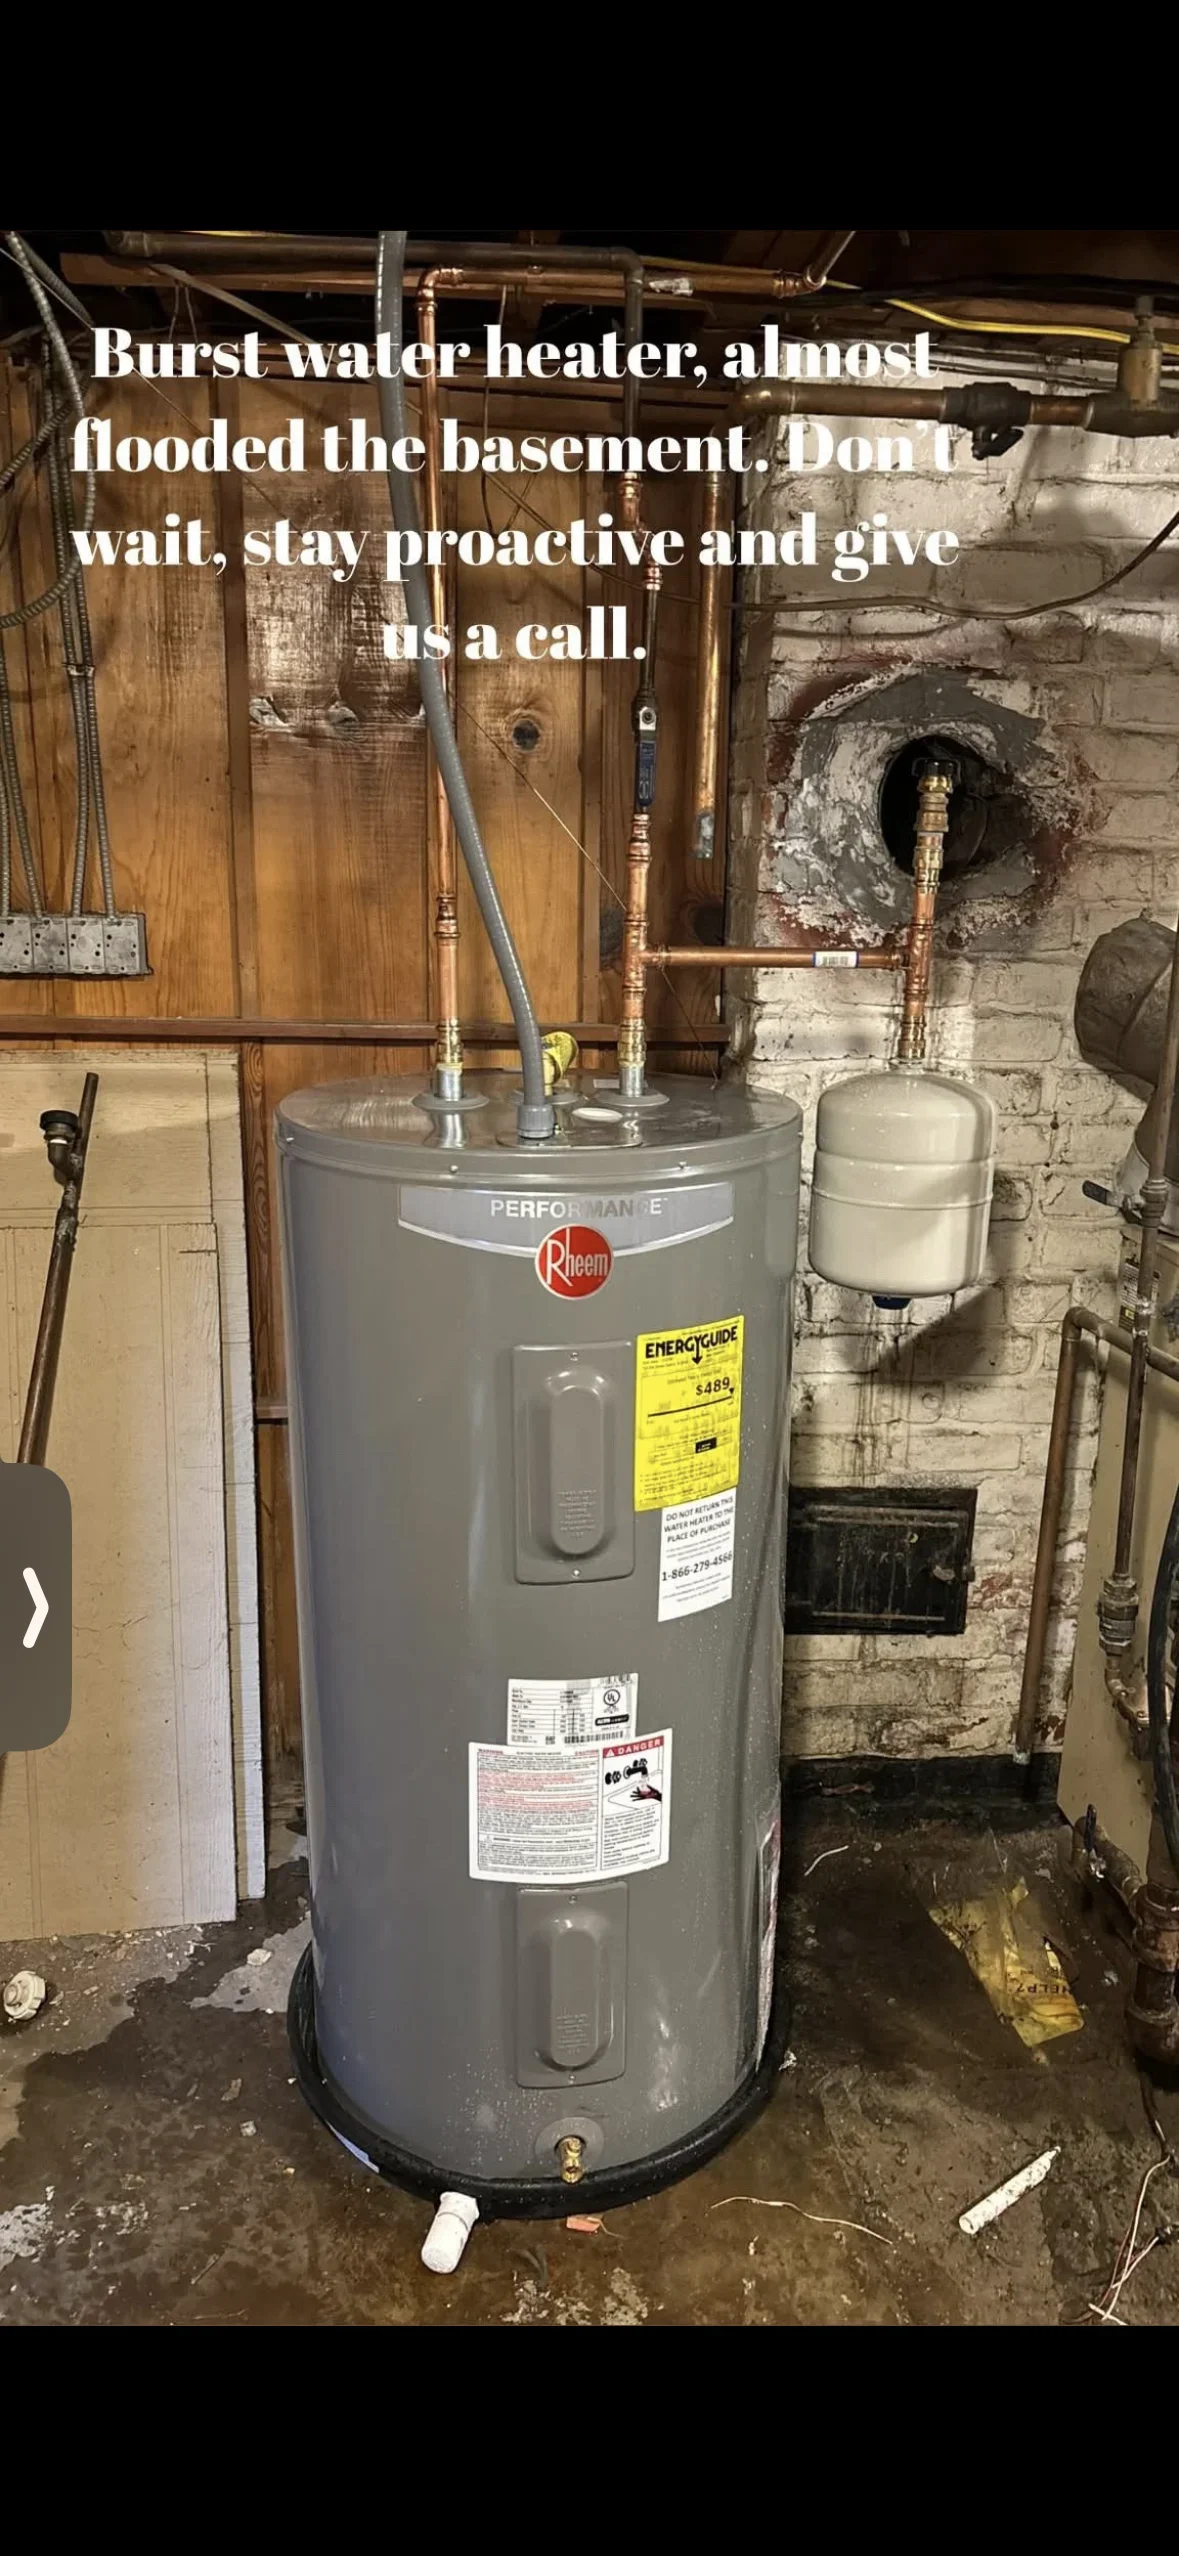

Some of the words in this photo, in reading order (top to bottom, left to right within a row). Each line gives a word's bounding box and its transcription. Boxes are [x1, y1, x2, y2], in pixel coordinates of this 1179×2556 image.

[546, 1228, 608, 1287] Rheem
[645, 1326, 738, 1361] ENERGYGUIDE
[696, 1376, 730, 1396] $489
[664, 1522, 688, 1532] WATER
[689, 1514, 713, 1526] HEATER
[714, 1510, 723, 1518] TO
[665, 1513, 677, 1522] DO
[679, 1508, 693, 1519] NOT
[695, 1502, 720, 1514] RETURN
[720, 1497, 734, 1506] THIS
[667, 1532, 688, 1543] PLACE
[690, 1530, 699, 1538] OF
[700, 1519, 731, 1535] PURCHASE
[661, 1550, 733, 1582] 1-866-279-4566
[617, 1738, 662, 1756] DANGER
